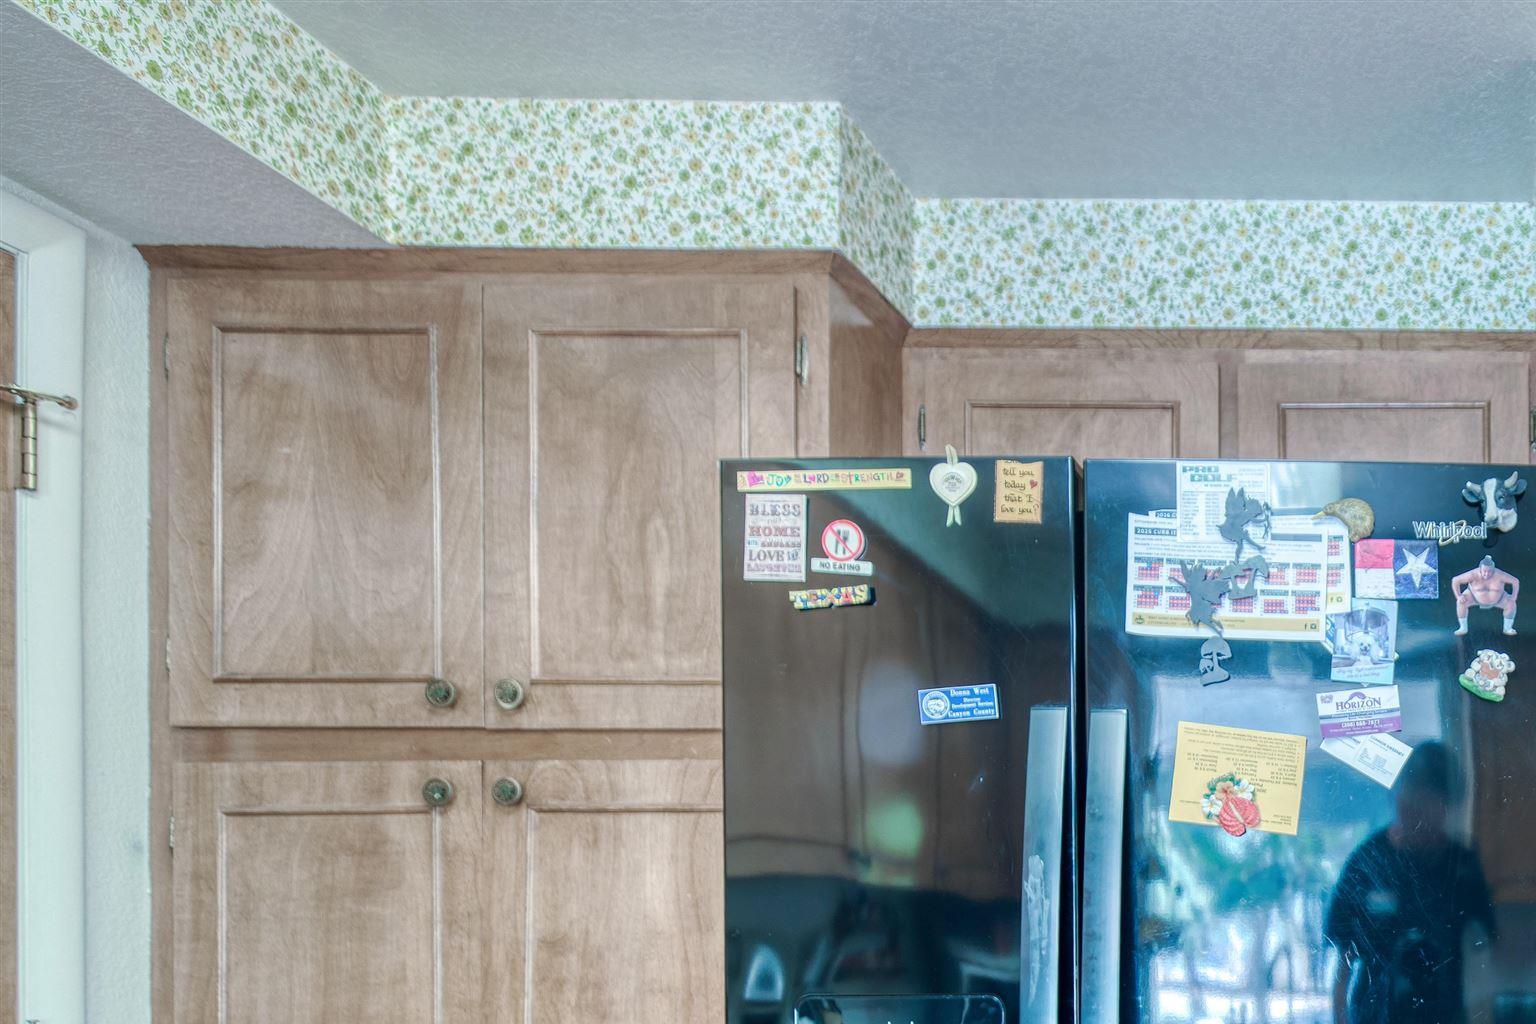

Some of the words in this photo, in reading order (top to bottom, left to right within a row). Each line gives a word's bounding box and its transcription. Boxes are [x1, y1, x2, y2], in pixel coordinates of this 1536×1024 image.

[1002, 467, 1016, 476] tell
[1019, 469, 1034, 478] you
[803, 473, 829, 484] LORD
[1004, 480, 1026, 490] today
[1004, 494, 1022, 502] that
[749, 503, 800, 517] BLESS
[1001, 504, 1014, 513] love
[748, 526, 800, 537] HOME
[1412, 520, 1488, 544] Whirlpool
[748, 549, 784, 561] LOVE
[819, 561, 830, 569] NO
[833, 562, 860, 571] EATING
[789, 584, 868, 610] TEXAS
[1336, 697, 1381, 711] HORIZON
